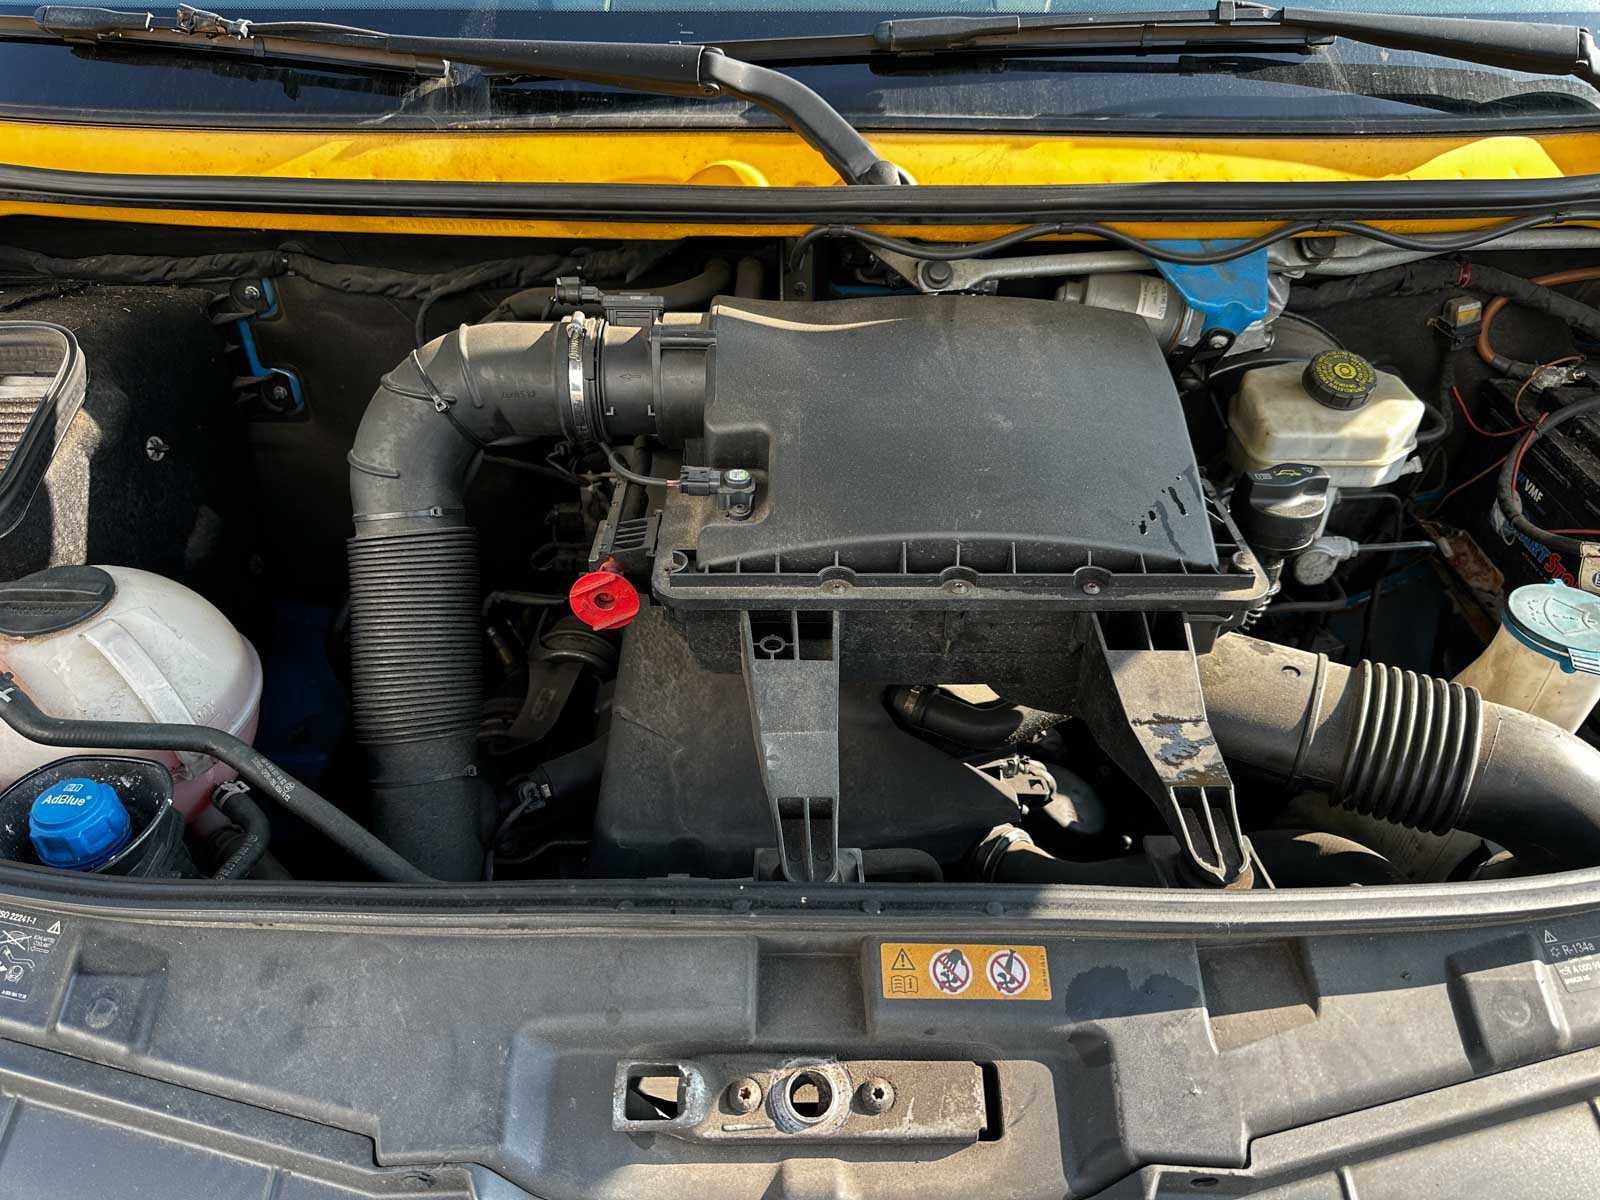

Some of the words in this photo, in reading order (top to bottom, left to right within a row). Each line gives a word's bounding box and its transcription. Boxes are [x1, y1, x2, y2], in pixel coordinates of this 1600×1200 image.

[1524, 479, 1544, 503] VMF
[1544, 552, 1576, 587] STO
[0, 909, 10, 919] SO
[9, 912, 37, 925] 22241-1
[1562, 942, 1595, 955] R-134a
